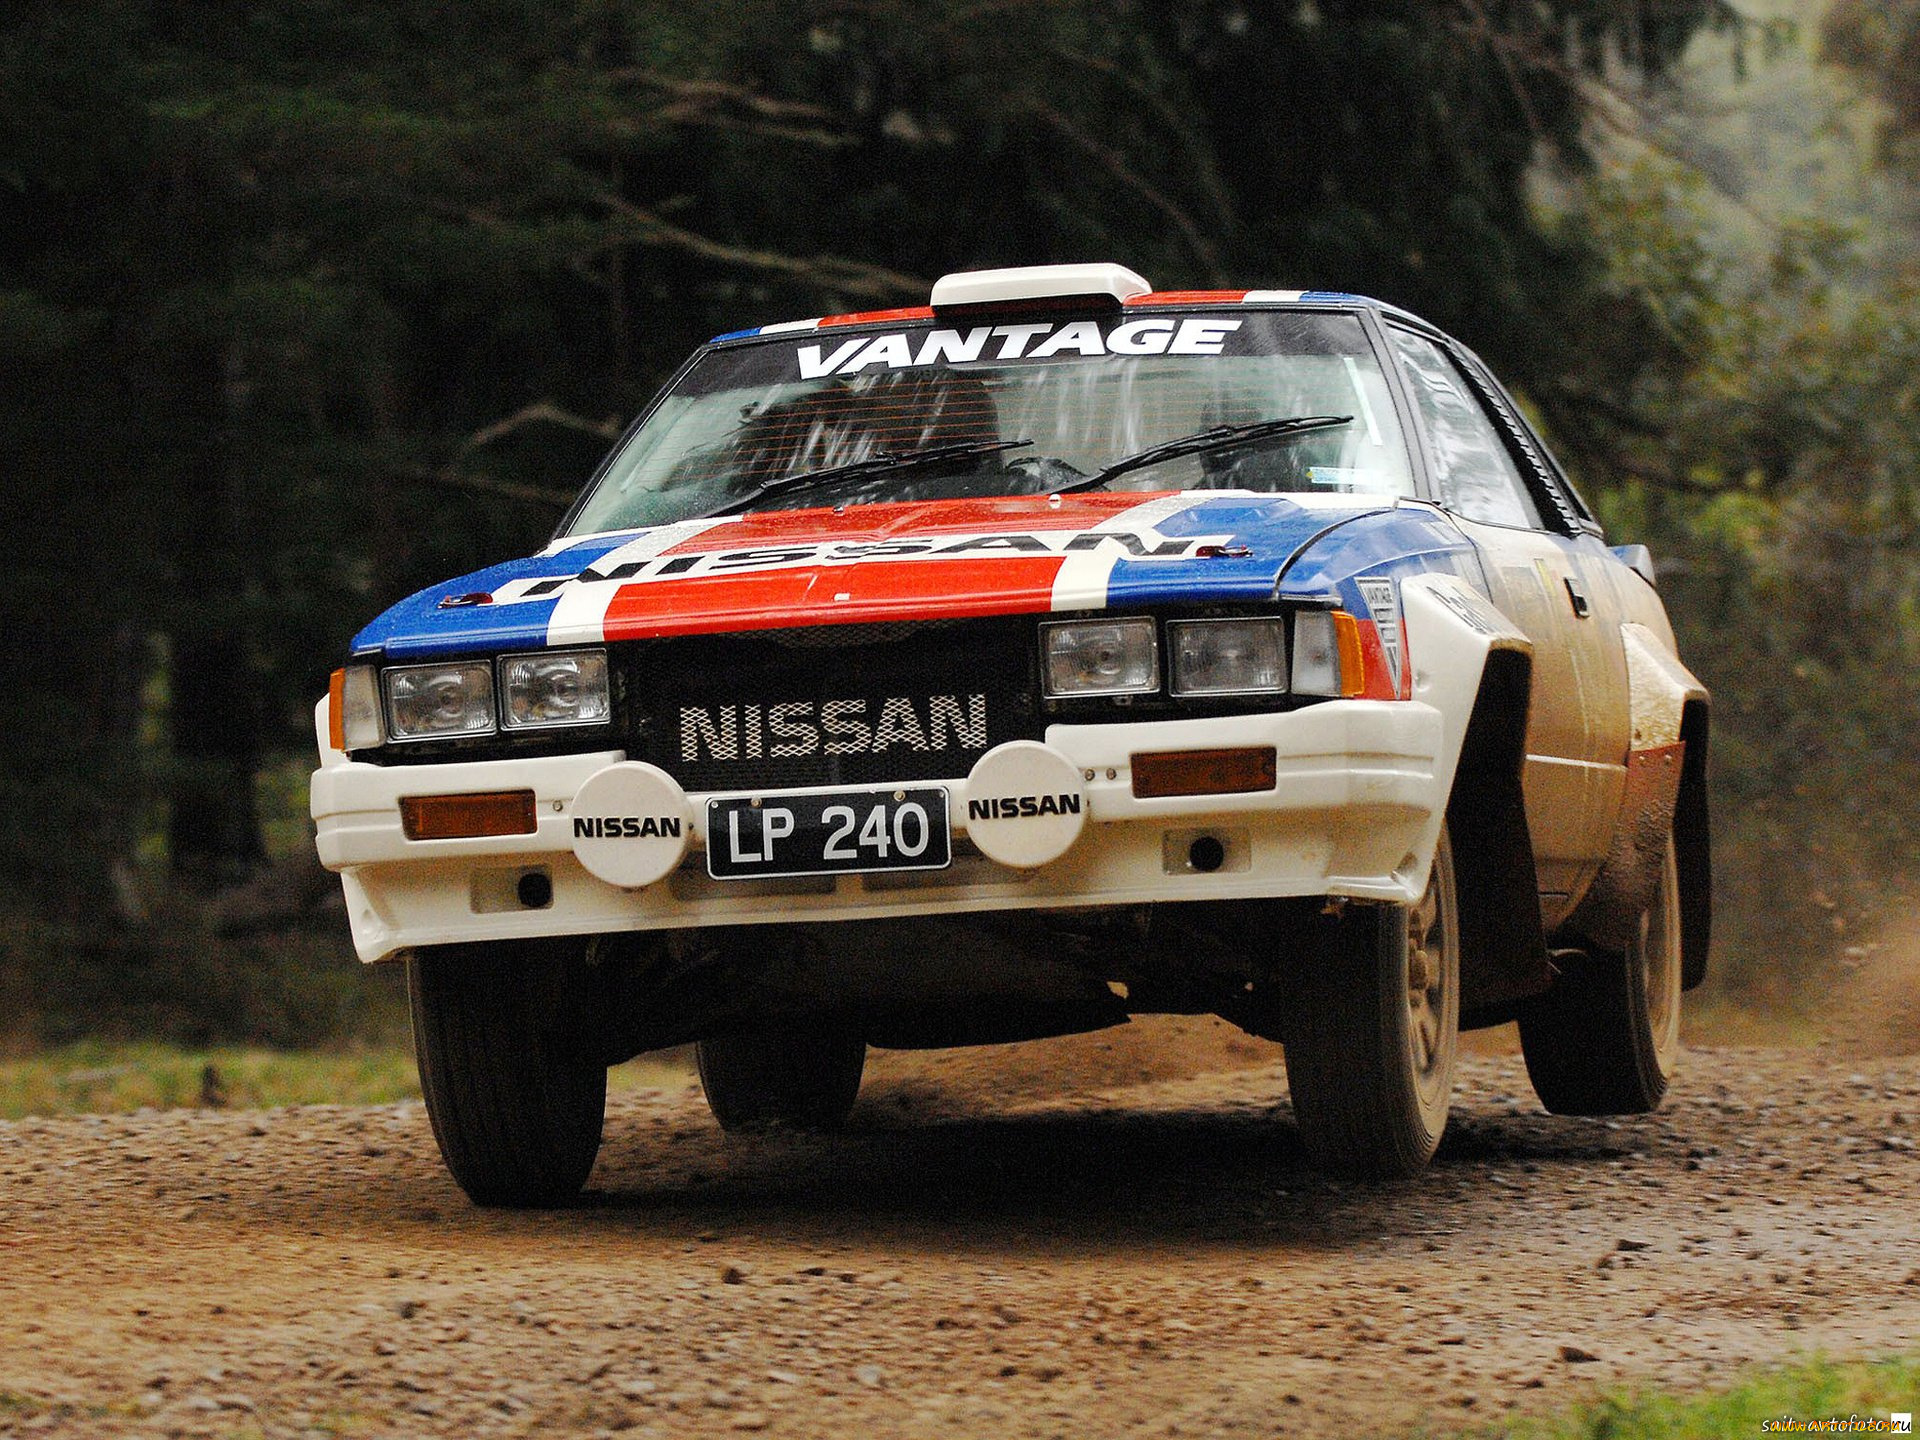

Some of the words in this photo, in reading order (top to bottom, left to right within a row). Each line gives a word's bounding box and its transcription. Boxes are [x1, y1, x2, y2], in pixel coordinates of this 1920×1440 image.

[797, 319, 1243, 380] VANTAGE
[520, 532, 1195, 598] NISSAN
[680, 694, 987, 762] NISSAN
[573, 816, 681, 839] NISSAN
[729, 807, 794, 864] LP
[821, 801, 930, 861] 240
[968, 793, 1081, 820] NISSAN
